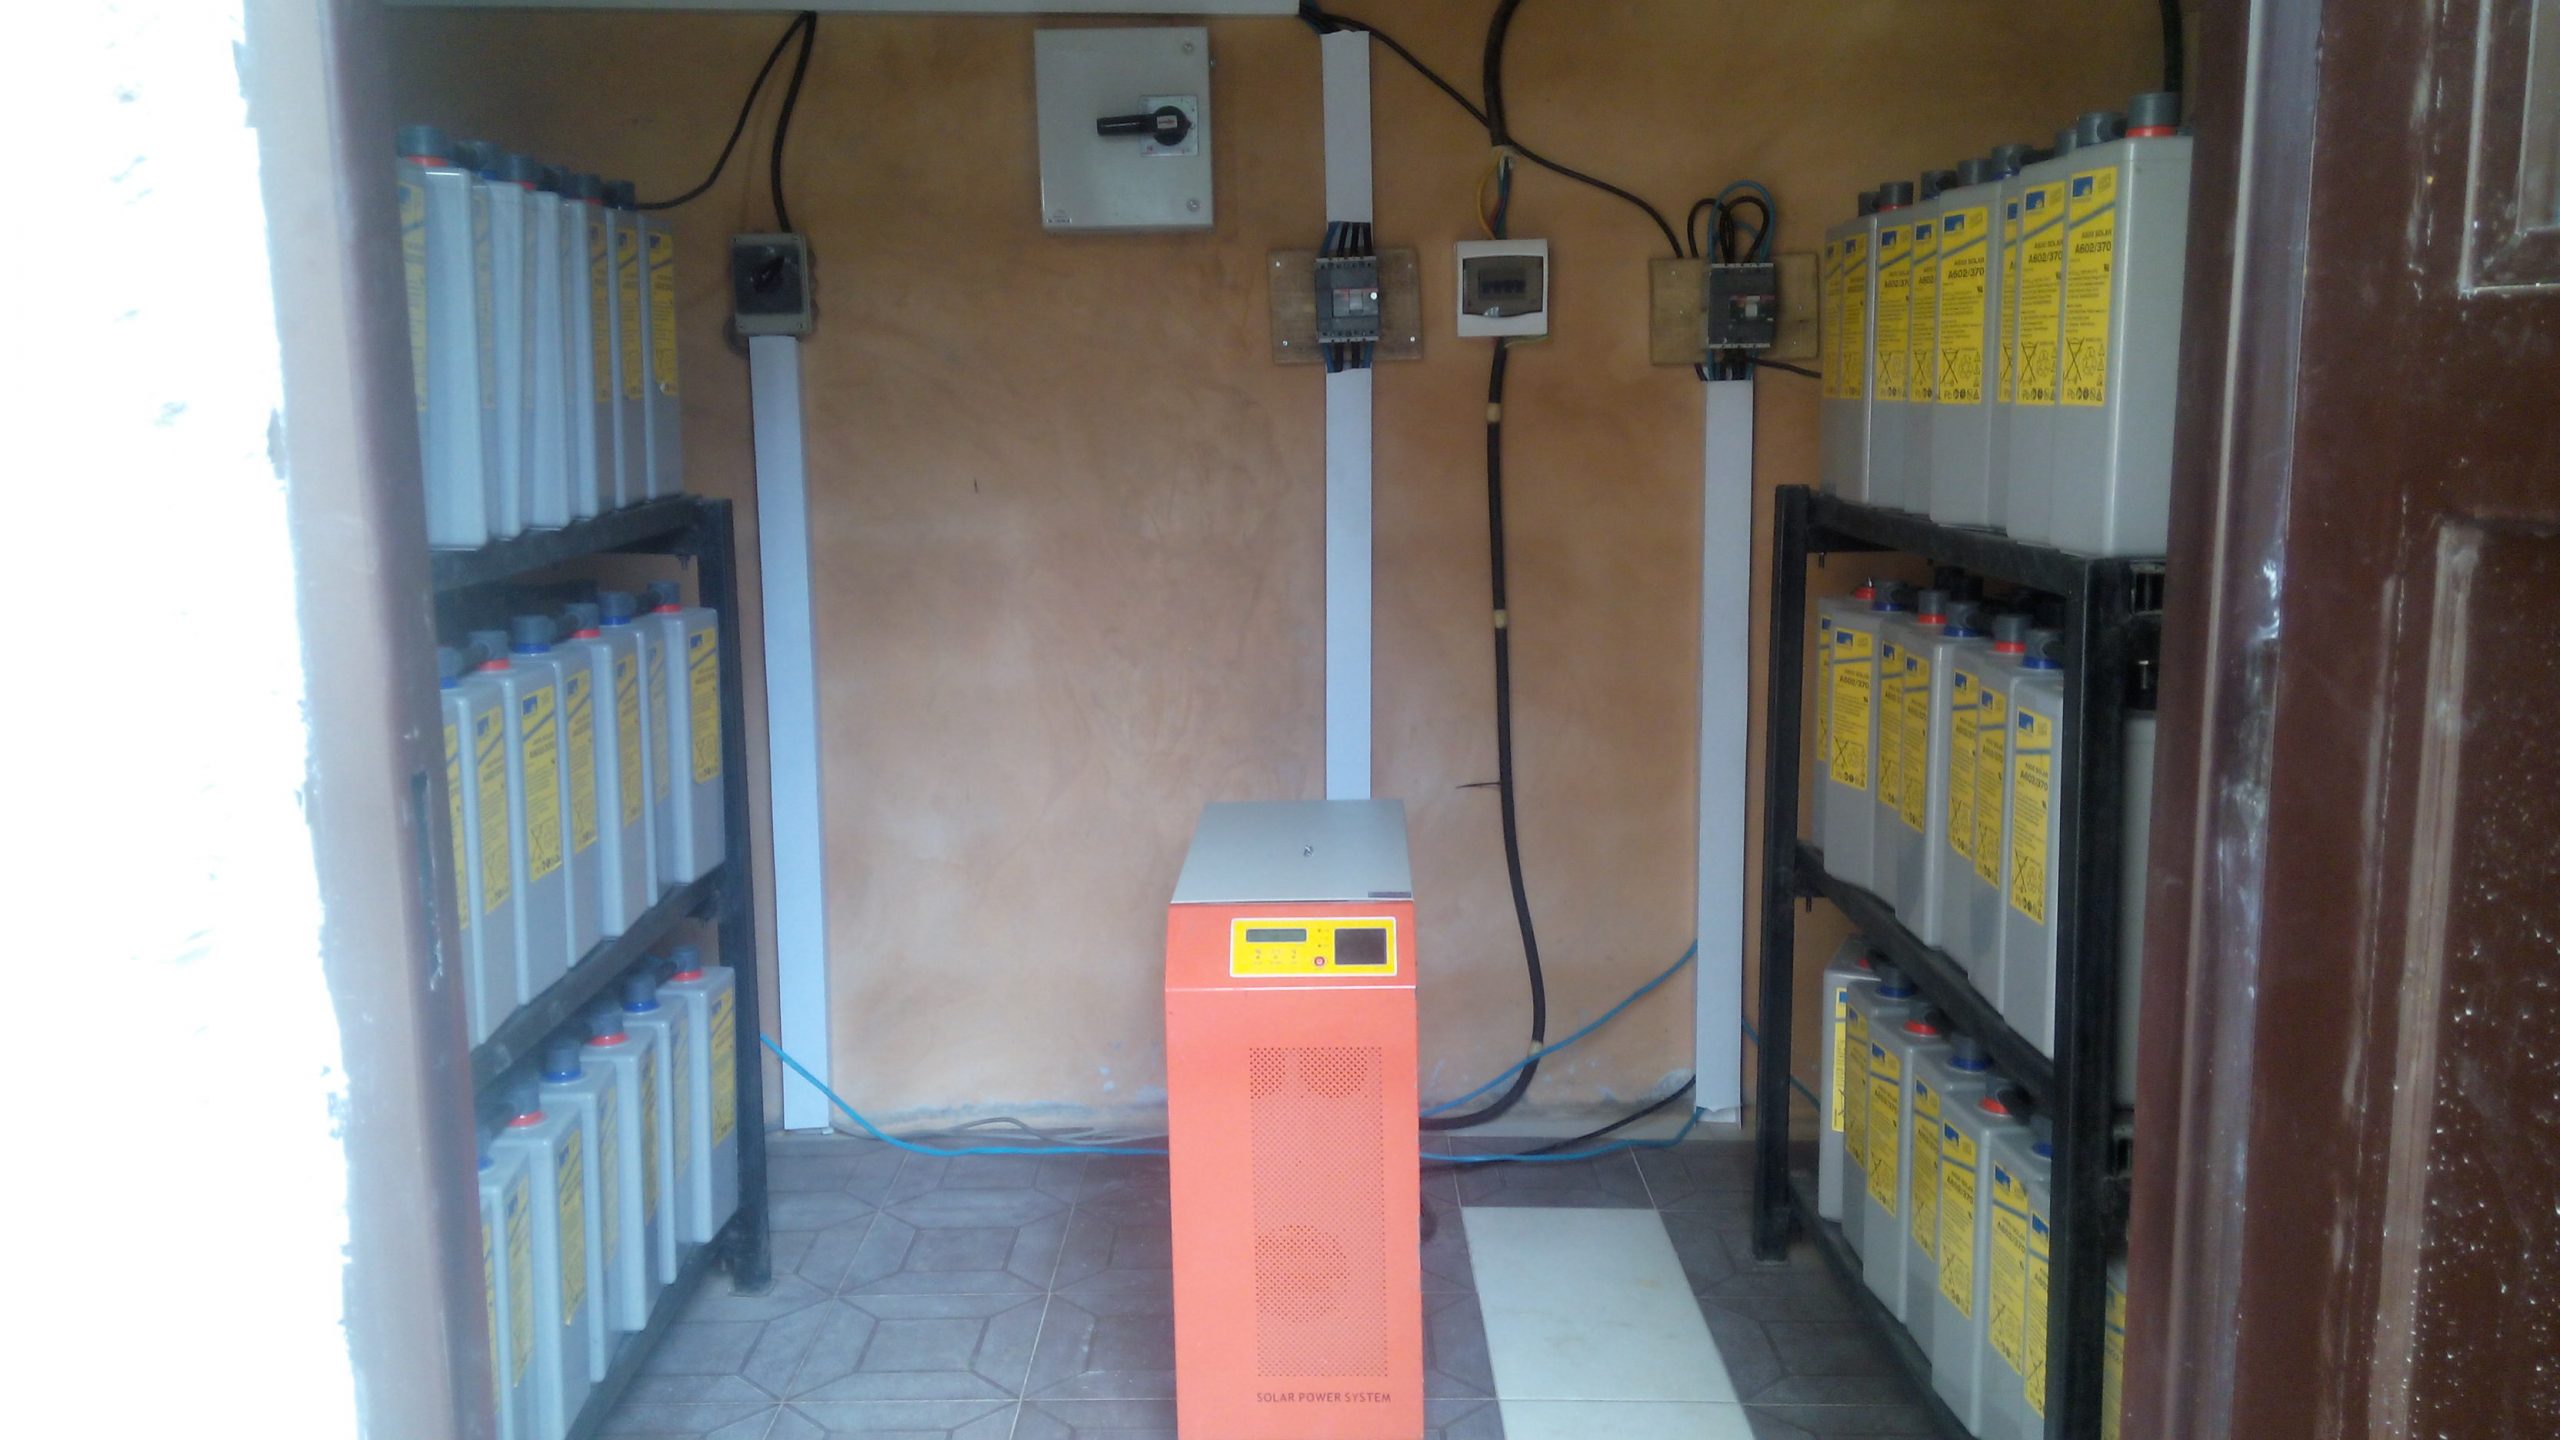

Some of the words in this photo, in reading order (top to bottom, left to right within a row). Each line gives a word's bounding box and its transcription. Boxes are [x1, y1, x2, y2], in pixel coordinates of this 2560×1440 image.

[2075, 241, 2112, 255] A602/370
[1948, 267, 1985, 280] A602/370
[1256, 1392, 1295, 1403] SOLAR
[1298, 1392, 1341, 1403] POWER
[1344, 1392, 1392, 1403] SYSTEM
